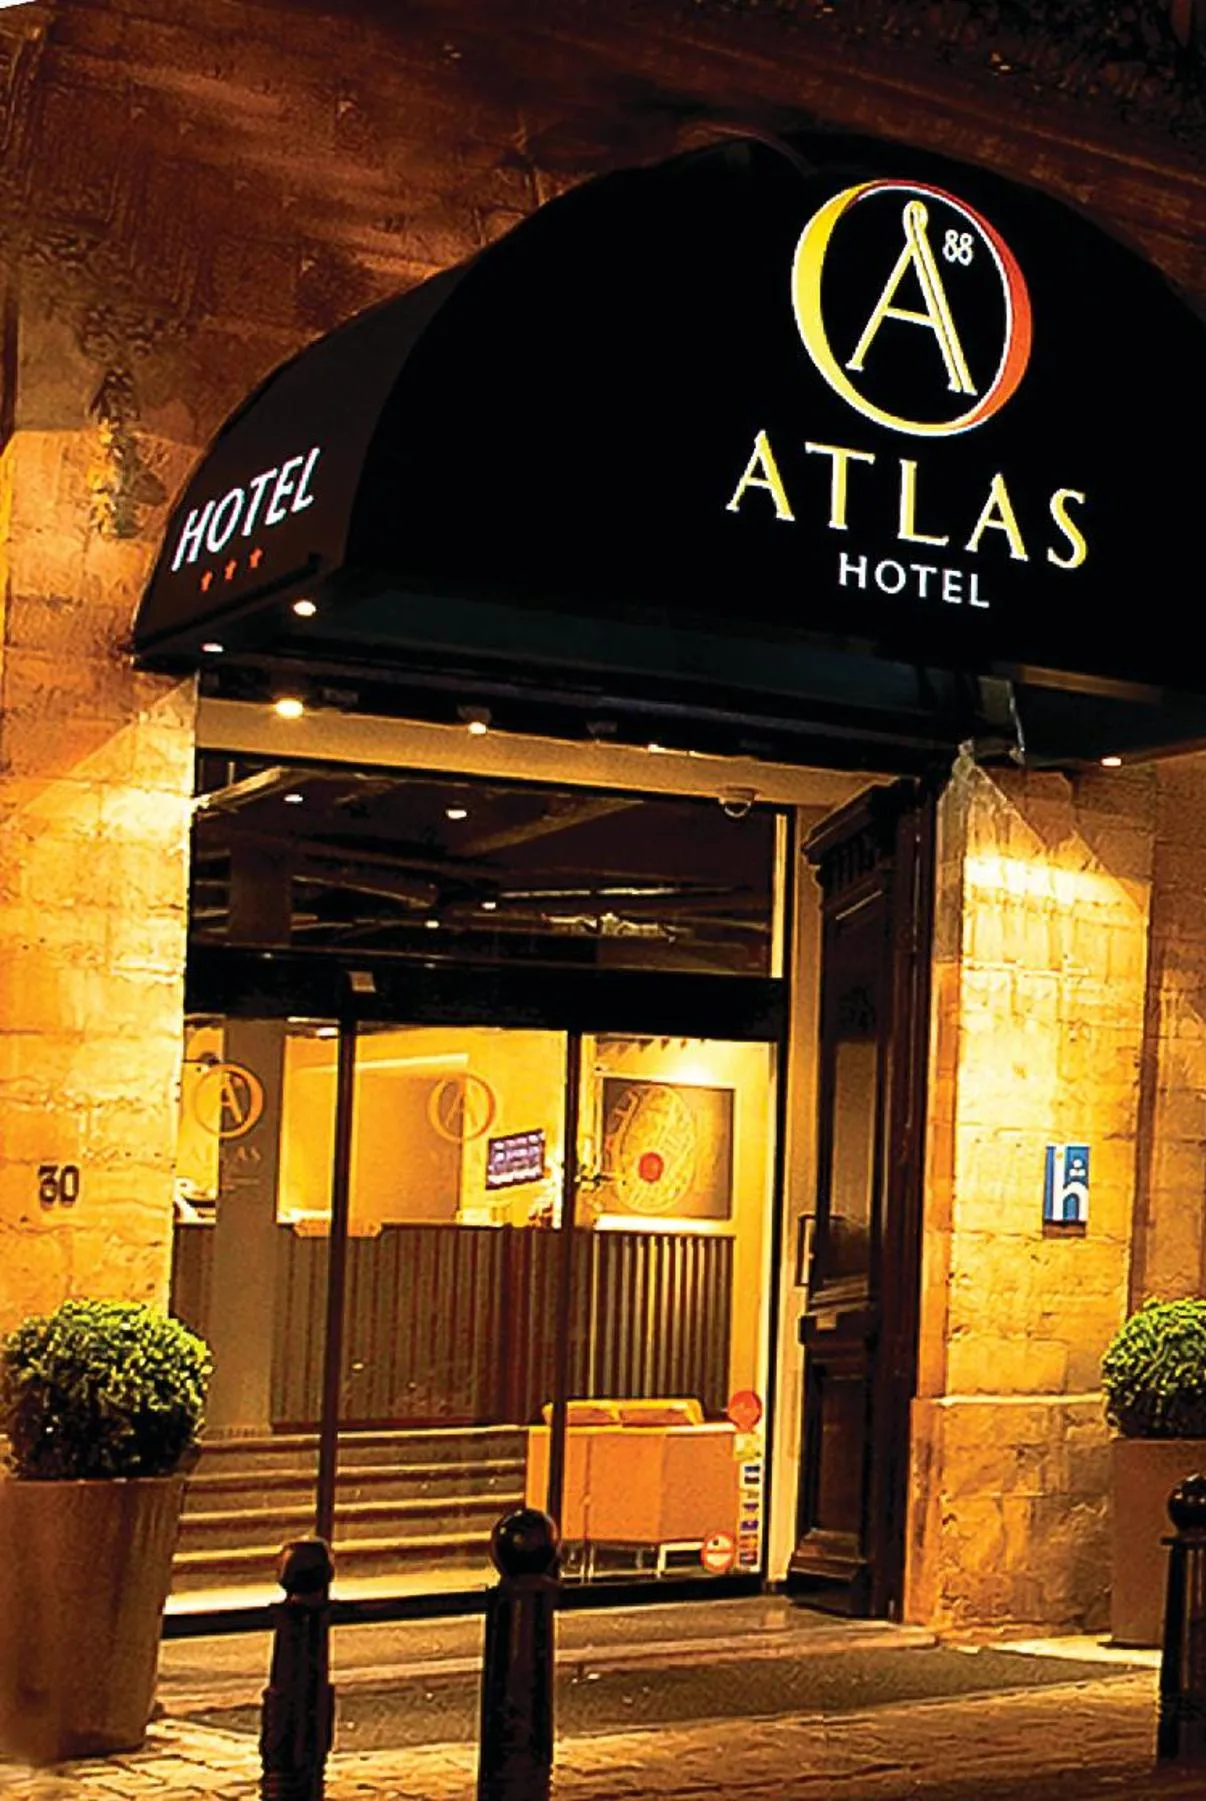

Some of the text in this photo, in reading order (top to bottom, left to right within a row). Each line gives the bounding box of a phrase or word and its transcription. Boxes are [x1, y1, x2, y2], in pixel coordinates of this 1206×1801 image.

[942, 229, 974, 266] 88
[171, 447, 320, 573] HOTEL
[726, 429, 1089, 570] ATLAS
[838, 552, 990, 608] HOTEL
[38, 1165, 79, 1203] 30
